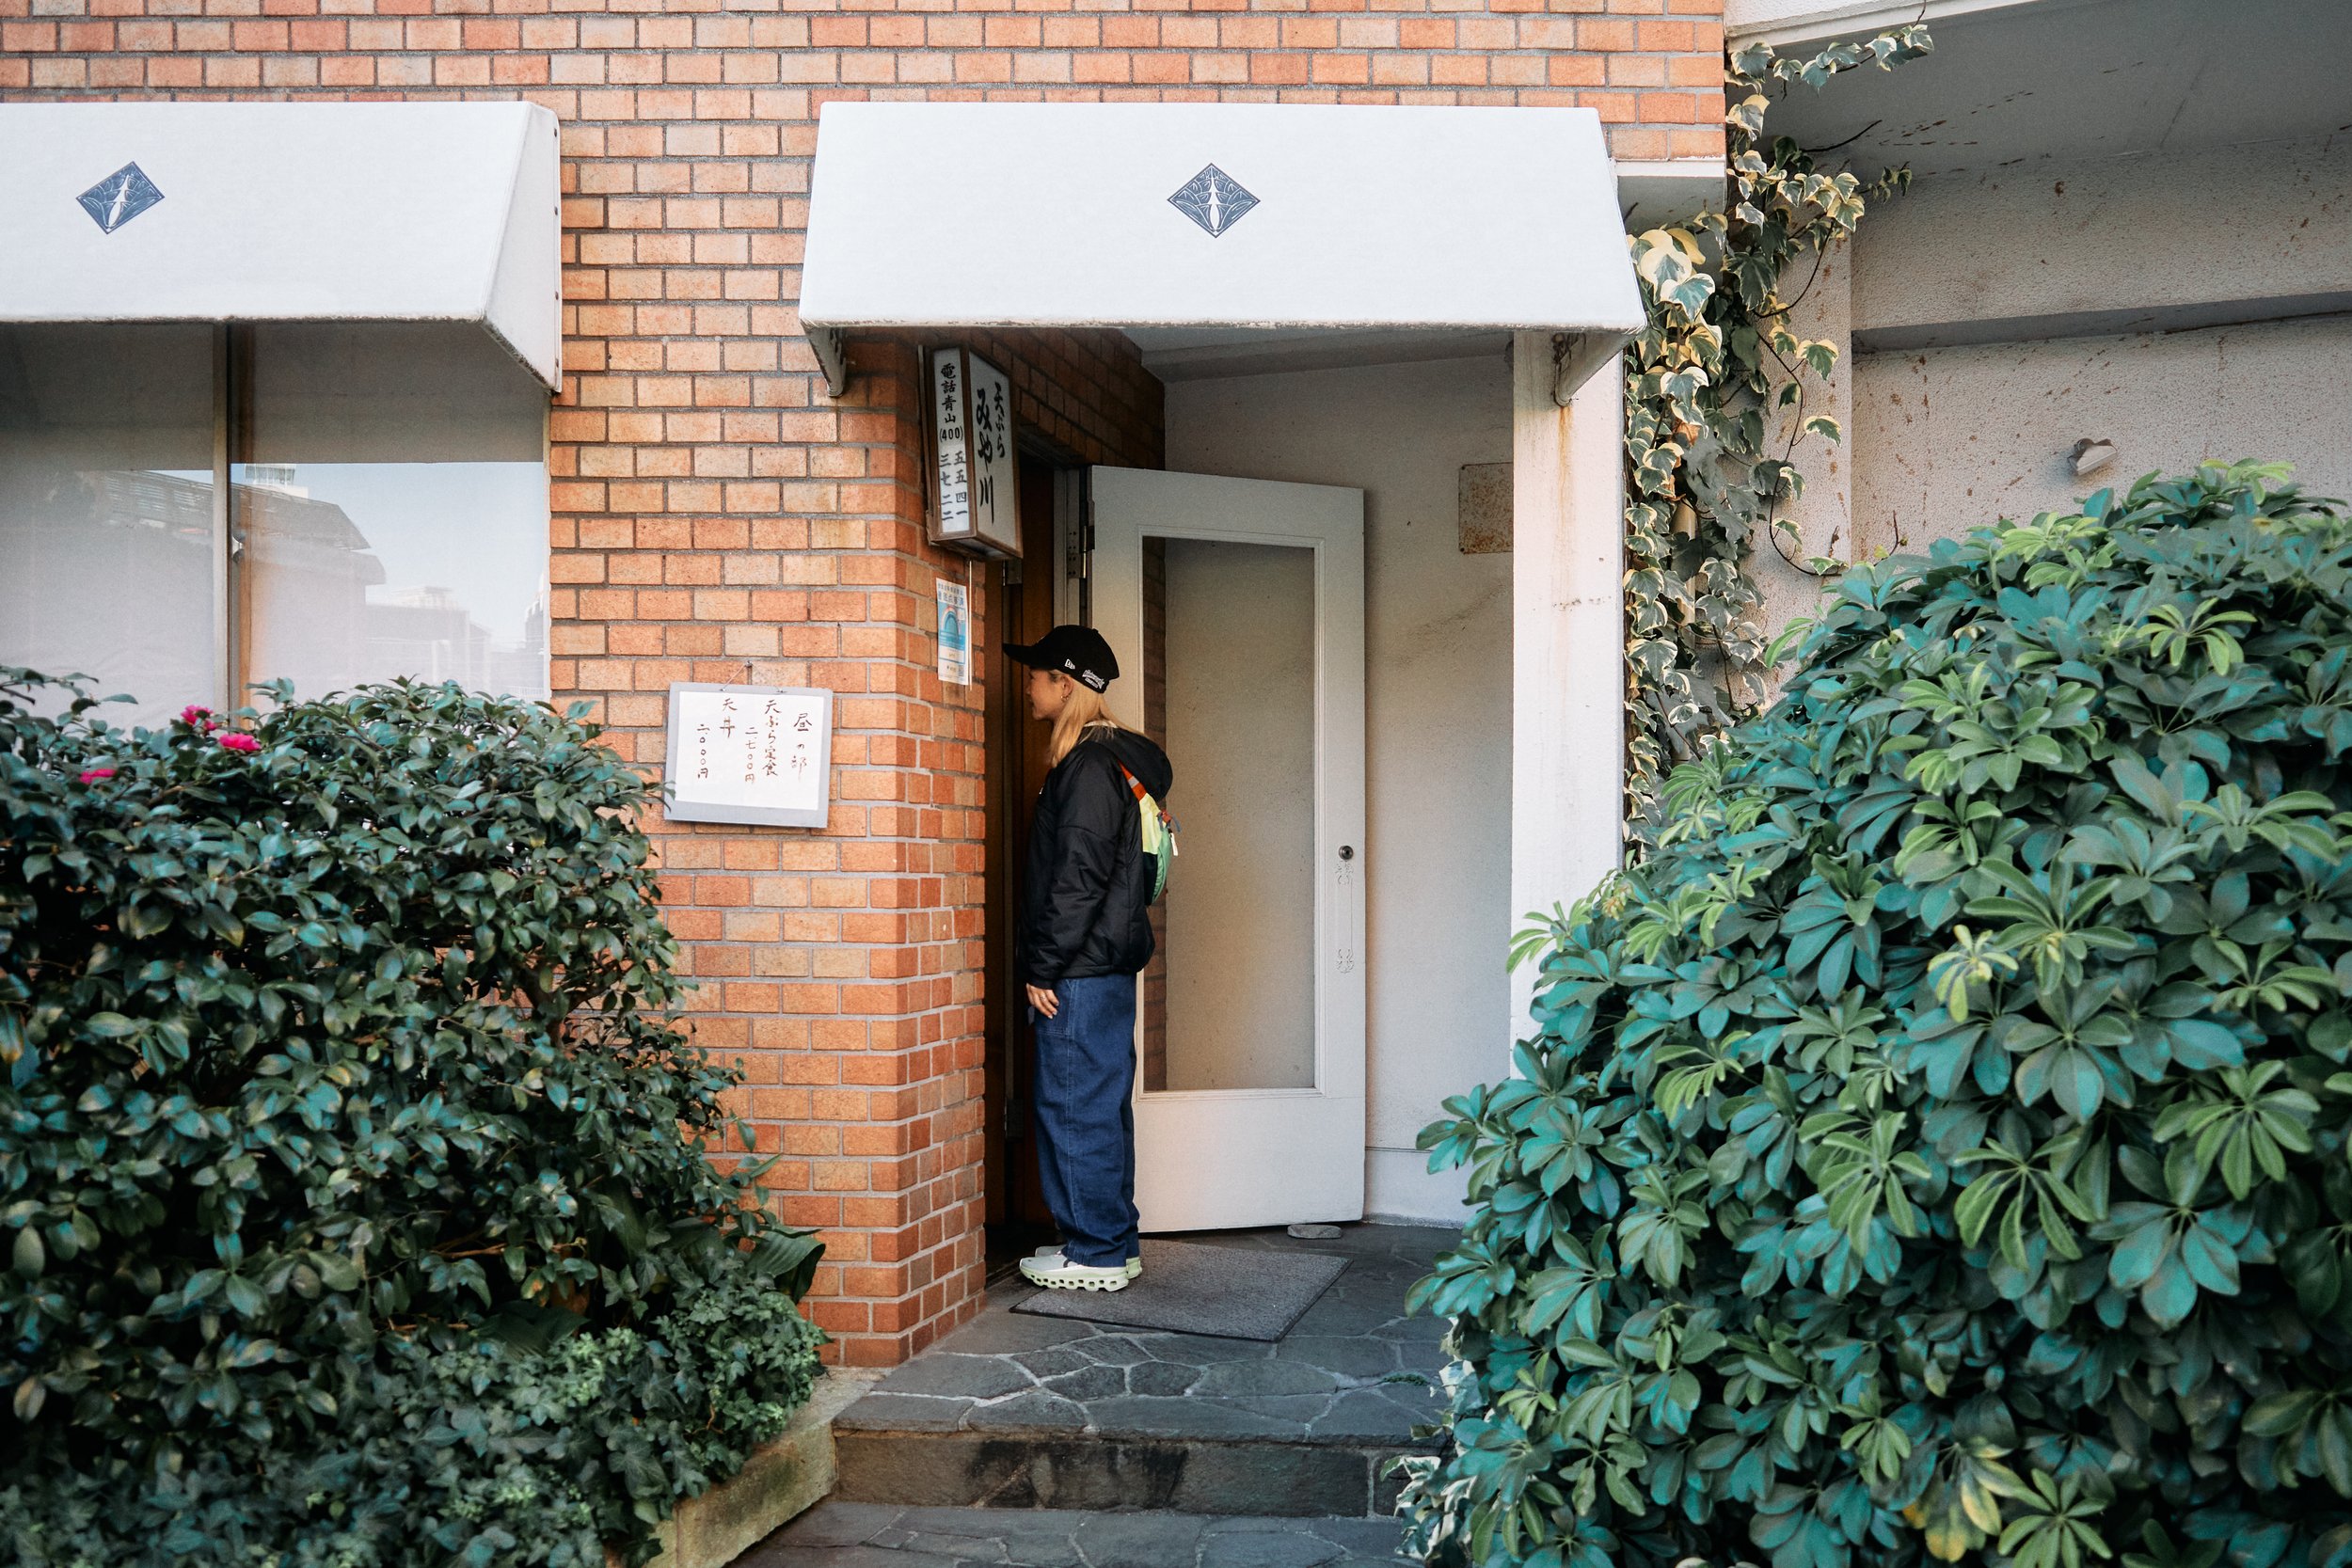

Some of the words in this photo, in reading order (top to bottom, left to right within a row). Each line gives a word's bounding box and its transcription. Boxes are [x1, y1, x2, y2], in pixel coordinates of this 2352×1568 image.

[941, 363, 957, 423] 電話青山
[939, 426, 963, 441] (400)
[940, 453, 954, 521] 三七二二
[954, 451, 968, 515] 五五四一
[791, 713, 813, 782] 昼の部
